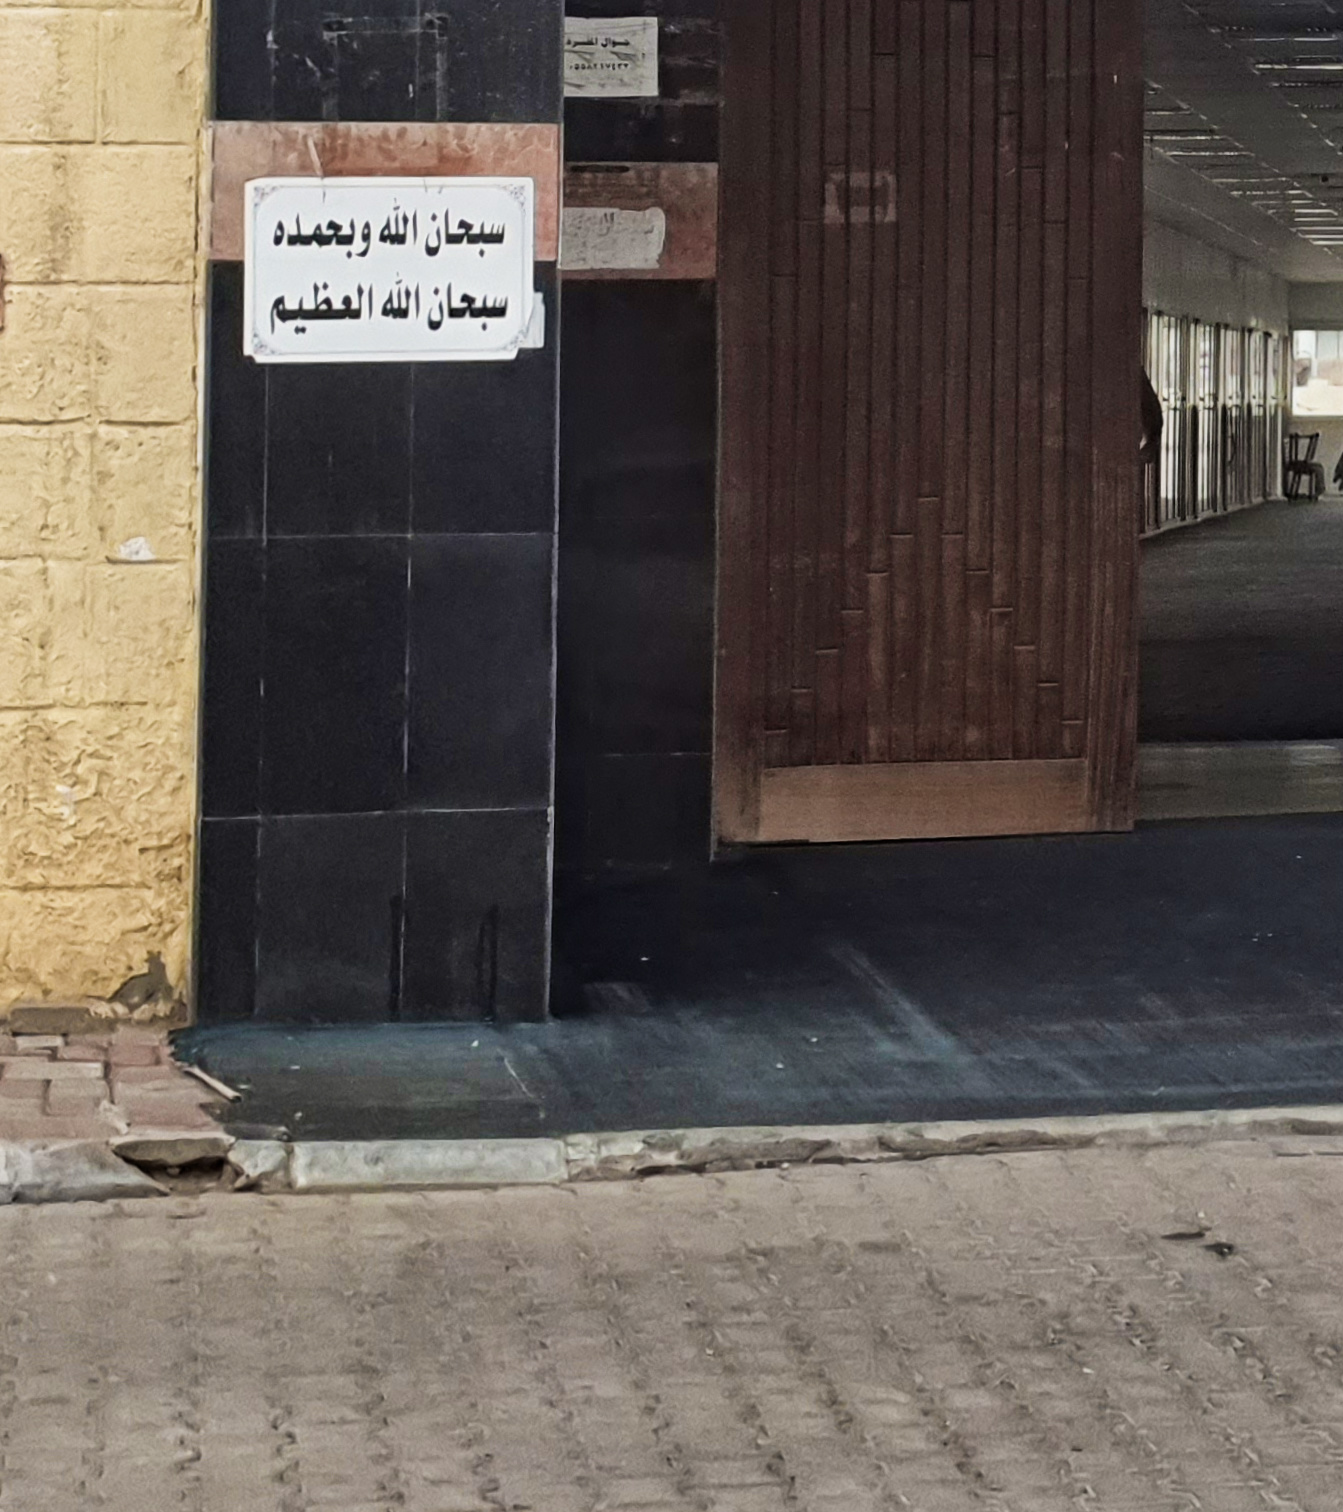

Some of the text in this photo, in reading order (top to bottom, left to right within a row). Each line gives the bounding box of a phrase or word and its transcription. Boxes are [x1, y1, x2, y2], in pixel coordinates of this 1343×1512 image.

[273, 197, 505, 259] سبحان الله وبحمده
[270, 271, 508, 335] سبحان الله العظيم
